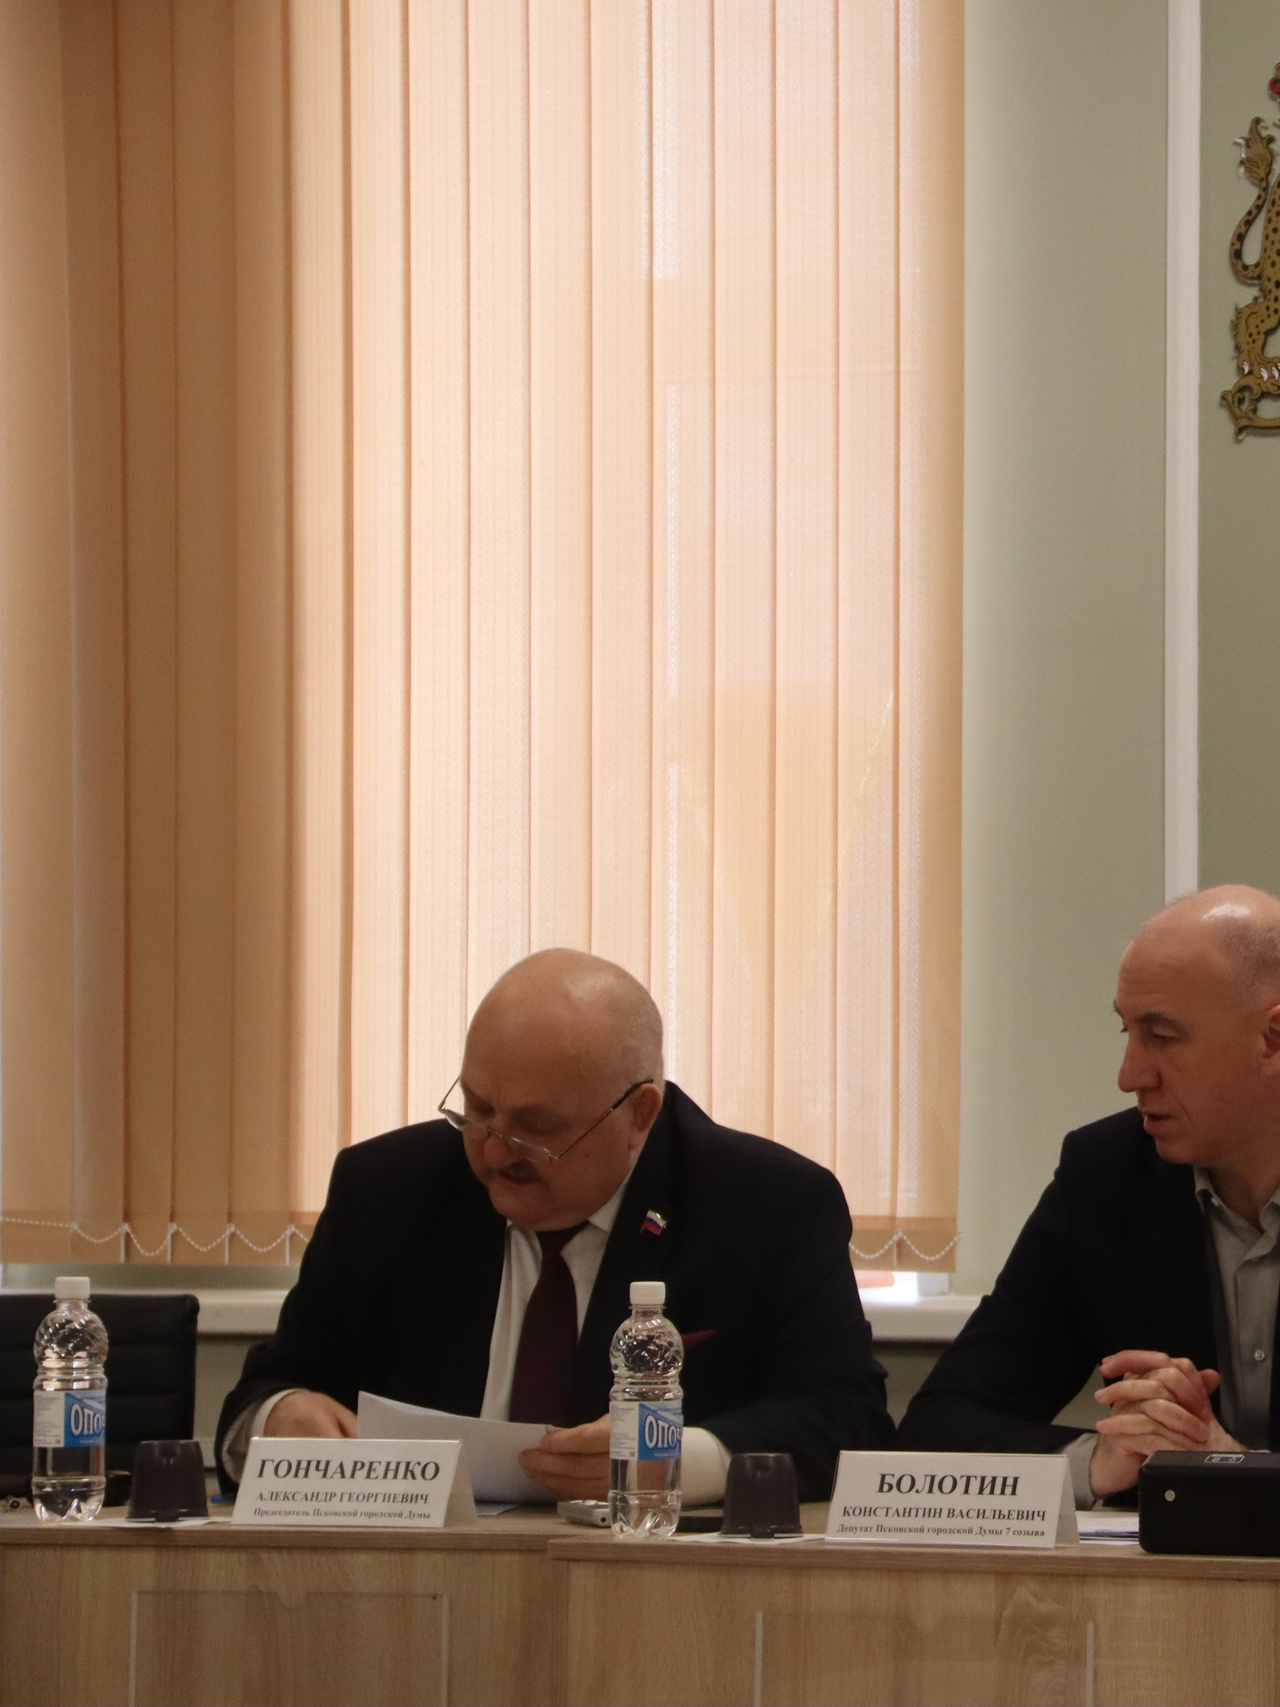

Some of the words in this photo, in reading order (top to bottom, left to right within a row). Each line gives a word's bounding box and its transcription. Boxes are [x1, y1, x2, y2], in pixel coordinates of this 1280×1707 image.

[257, 1459, 440, 1481] ГОНЧАРЕНКО
[877, 1473, 1021, 1496] БОЛОТИН
[255, 1491, 337, 1502] АЛЕКСАНДР
[339, 1492, 429, 1504] ГЕОРГИЕВИЧ
[253, 1508, 310, 1518] Председатель
[313, 1508, 358, 1517] Псковской
[360, 1509, 403, 1520] городской
[405, 1510, 431, 1520] Думы
[842, 1506, 943, 1518] КОНСТАНТИН
[946, 1508, 1046, 1521] ВАСИЛЬЕВИЧ
[837, 1524, 873, 1534] Депутат
[876, 1524, 925, 1534] Псковской
[927, 1526, 973, 1535] городской
[975, 1526, 1002, 1537] Думы
[1006, 1527, 1011, 1536] 7
[1012, 1529, 1045, 1537] созыва
